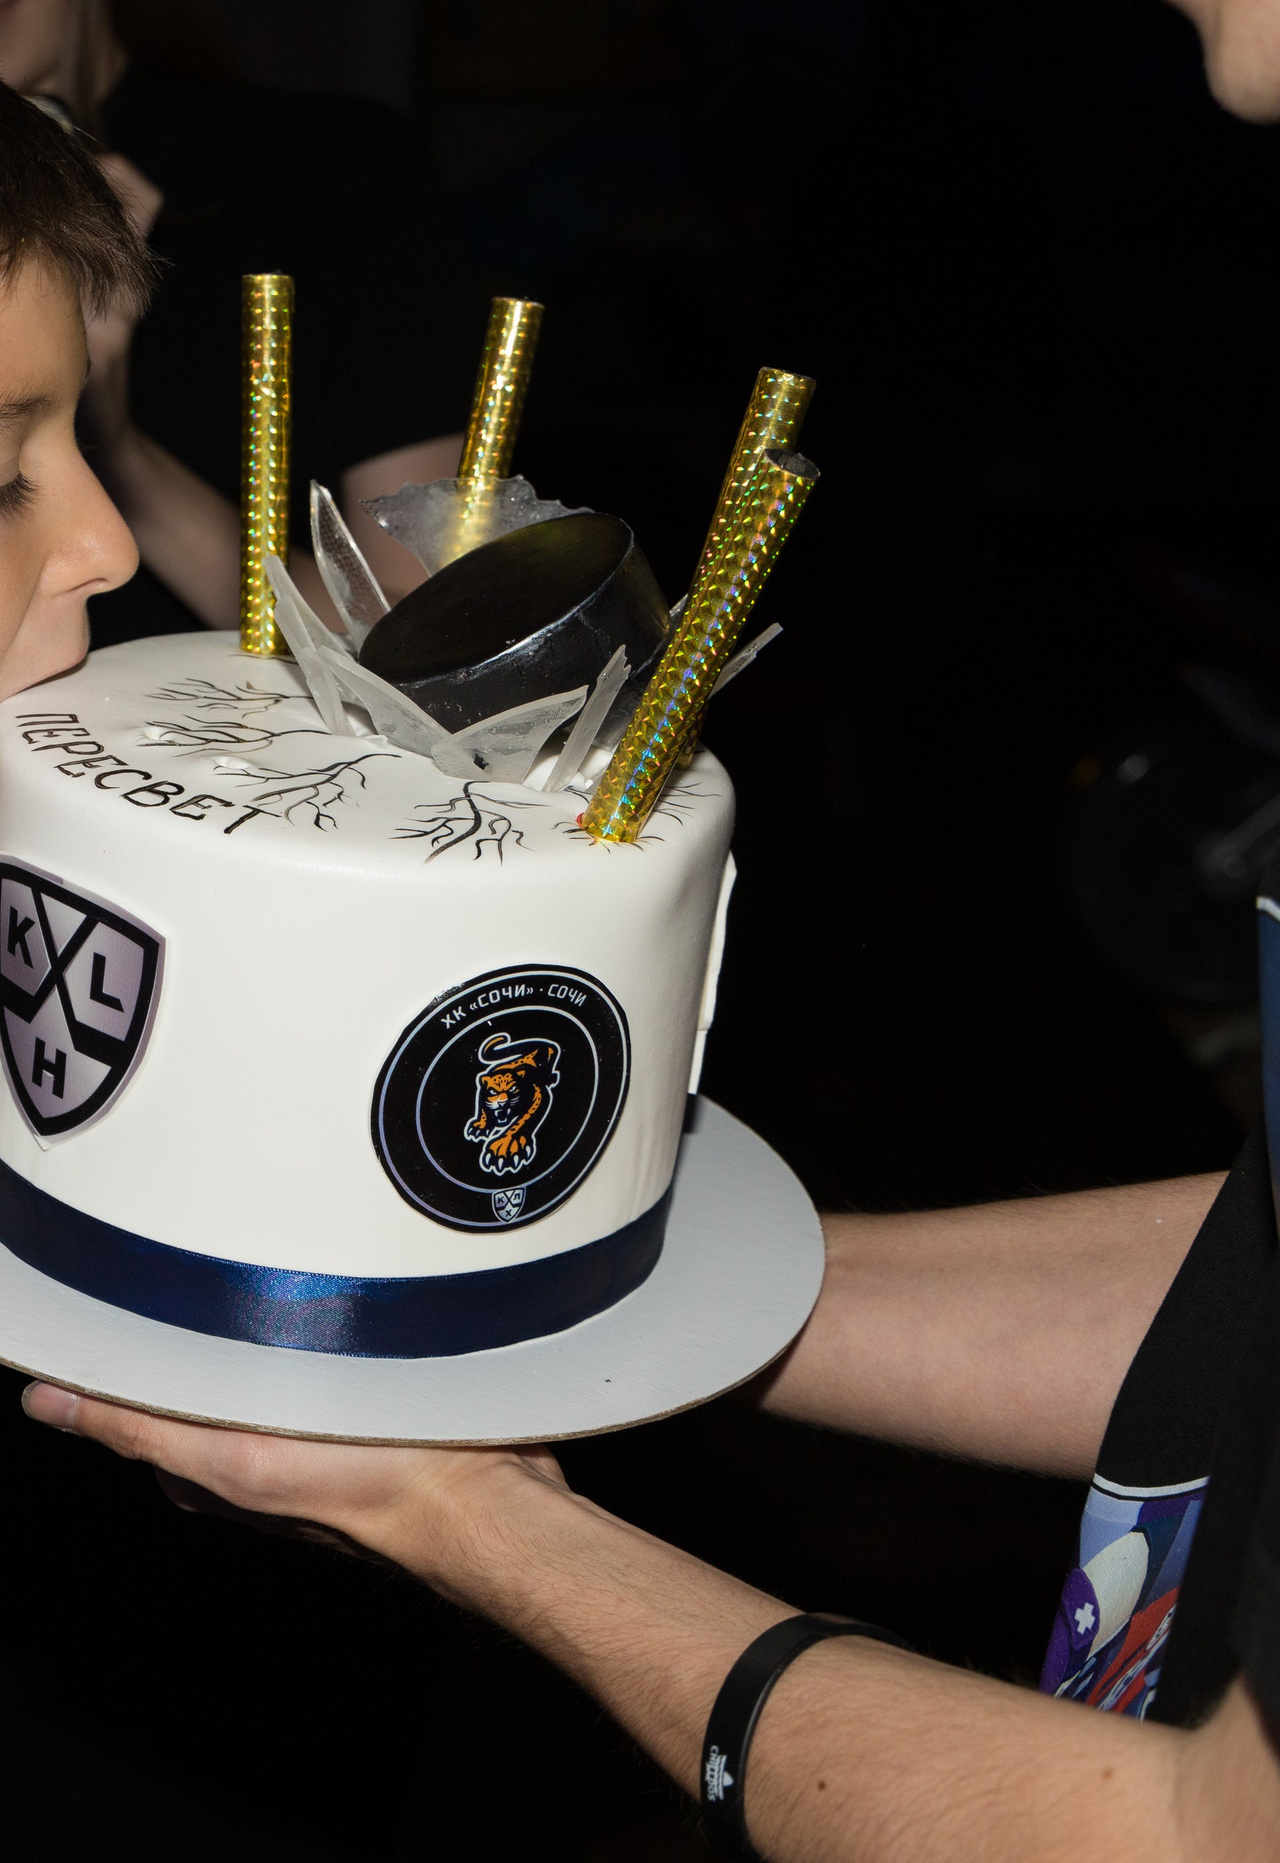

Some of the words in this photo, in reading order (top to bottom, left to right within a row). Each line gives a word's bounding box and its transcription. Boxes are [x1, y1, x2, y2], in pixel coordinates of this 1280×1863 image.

[15, 713, 282, 834] ПЕРЕСВЕТ
[440, 1005, 467, 1029] ХК
[469, 984, 534, 1011] «СОЧИ»
[547, 984, 588, 1007] СОЧИ
